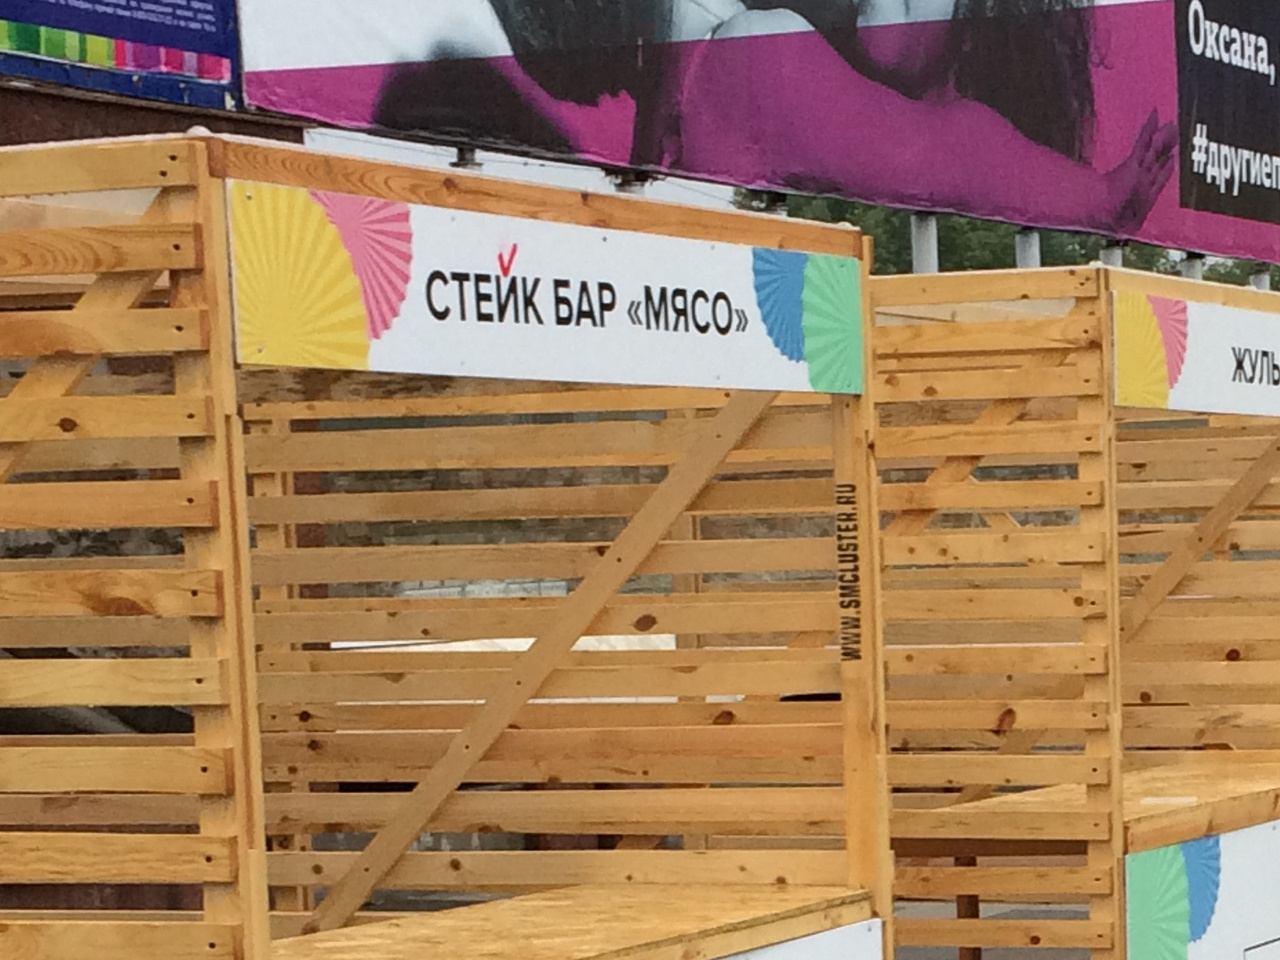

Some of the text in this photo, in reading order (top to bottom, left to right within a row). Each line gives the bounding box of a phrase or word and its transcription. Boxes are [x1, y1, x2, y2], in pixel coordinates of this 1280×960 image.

[1189, 0, 1275, 86] Оксана,
[553, 278, 616, 327] БАР
[627, 285, 749, 336] «МЯСО»
[836, 484, 862, 662] WWW.SMCLUSTER.RU
